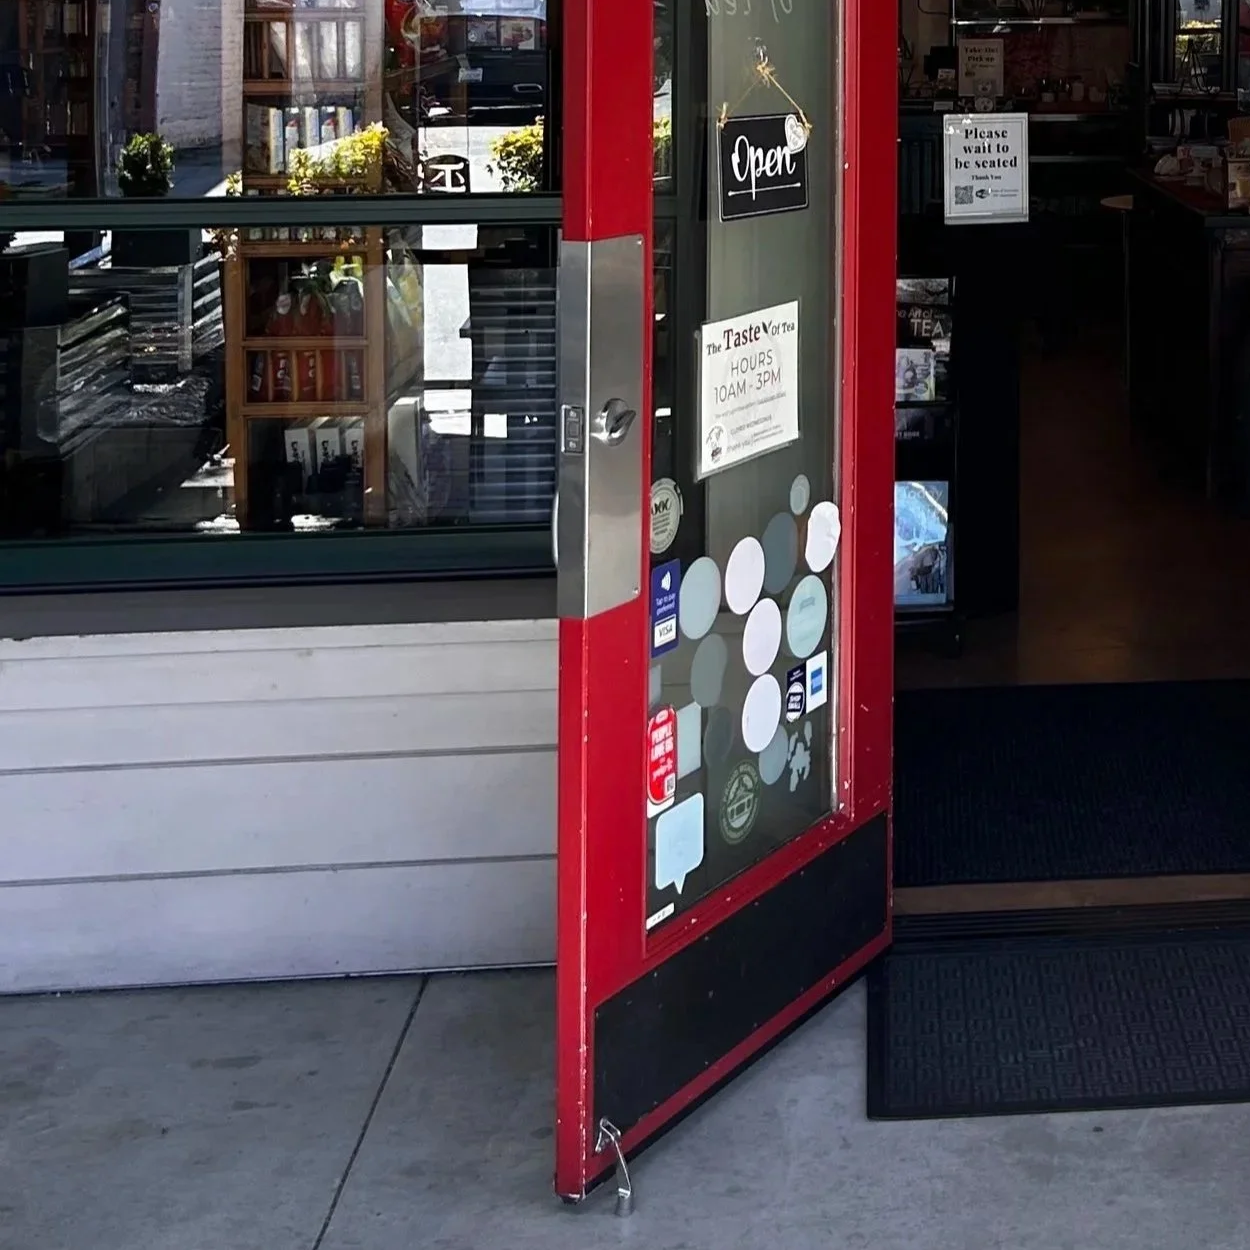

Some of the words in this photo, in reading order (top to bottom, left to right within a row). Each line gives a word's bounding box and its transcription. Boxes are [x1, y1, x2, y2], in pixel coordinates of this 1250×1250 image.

[964, 128, 1008, 140] Please
[963, 141, 992, 154] wait
[997, 142, 1010, 154] to
[731, 134, 796, 202] Open
[955, 158, 971, 169] be
[974, 156, 1018, 169] seated
[910, 319, 944, 338] TEA
[706, 342, 722, 356] The
[723, 323, 761, 351] Taste
[771, 322, 781, 336] Of
[781, 321, 795, 333] Tea
[731, 349, 773, 377] HOURS
[714, 378, 746, 405] 10AM
[756, 366, 781, 390] 3PM
[658, 623, 673, 638] VISA
[787, 701, 801, 711] SMALL
[789, 694, 802, 703] SHOP
[651, 722, 674, 748] PEOPLE
